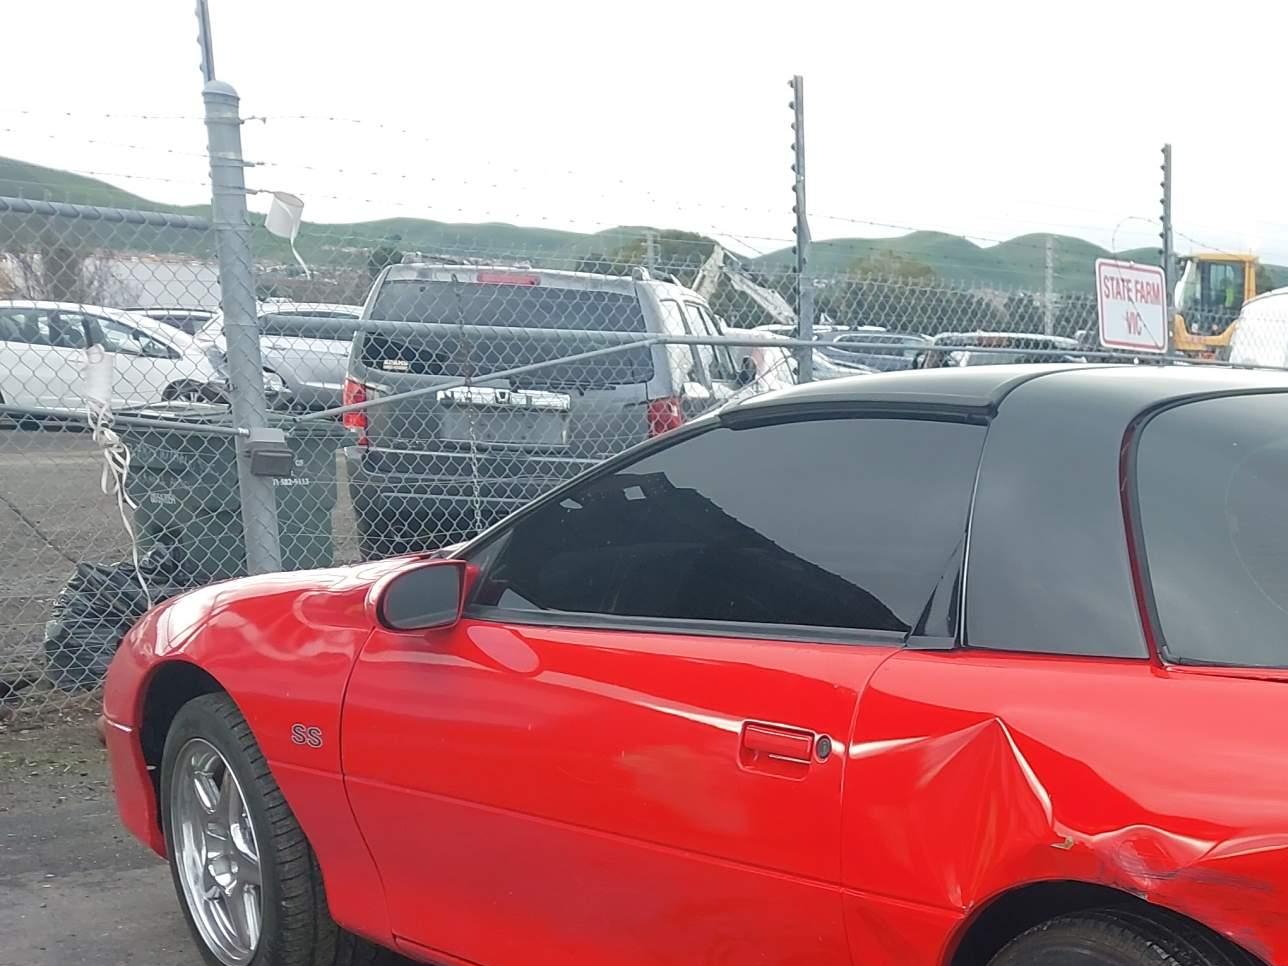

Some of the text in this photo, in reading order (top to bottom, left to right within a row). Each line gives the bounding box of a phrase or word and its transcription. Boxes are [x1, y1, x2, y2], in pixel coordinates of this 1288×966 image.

[1103, 275, 1160, 305] STATE FARM
[1126, 311, 1143, 336] VIC
[291, 723, 323, 748] SS
